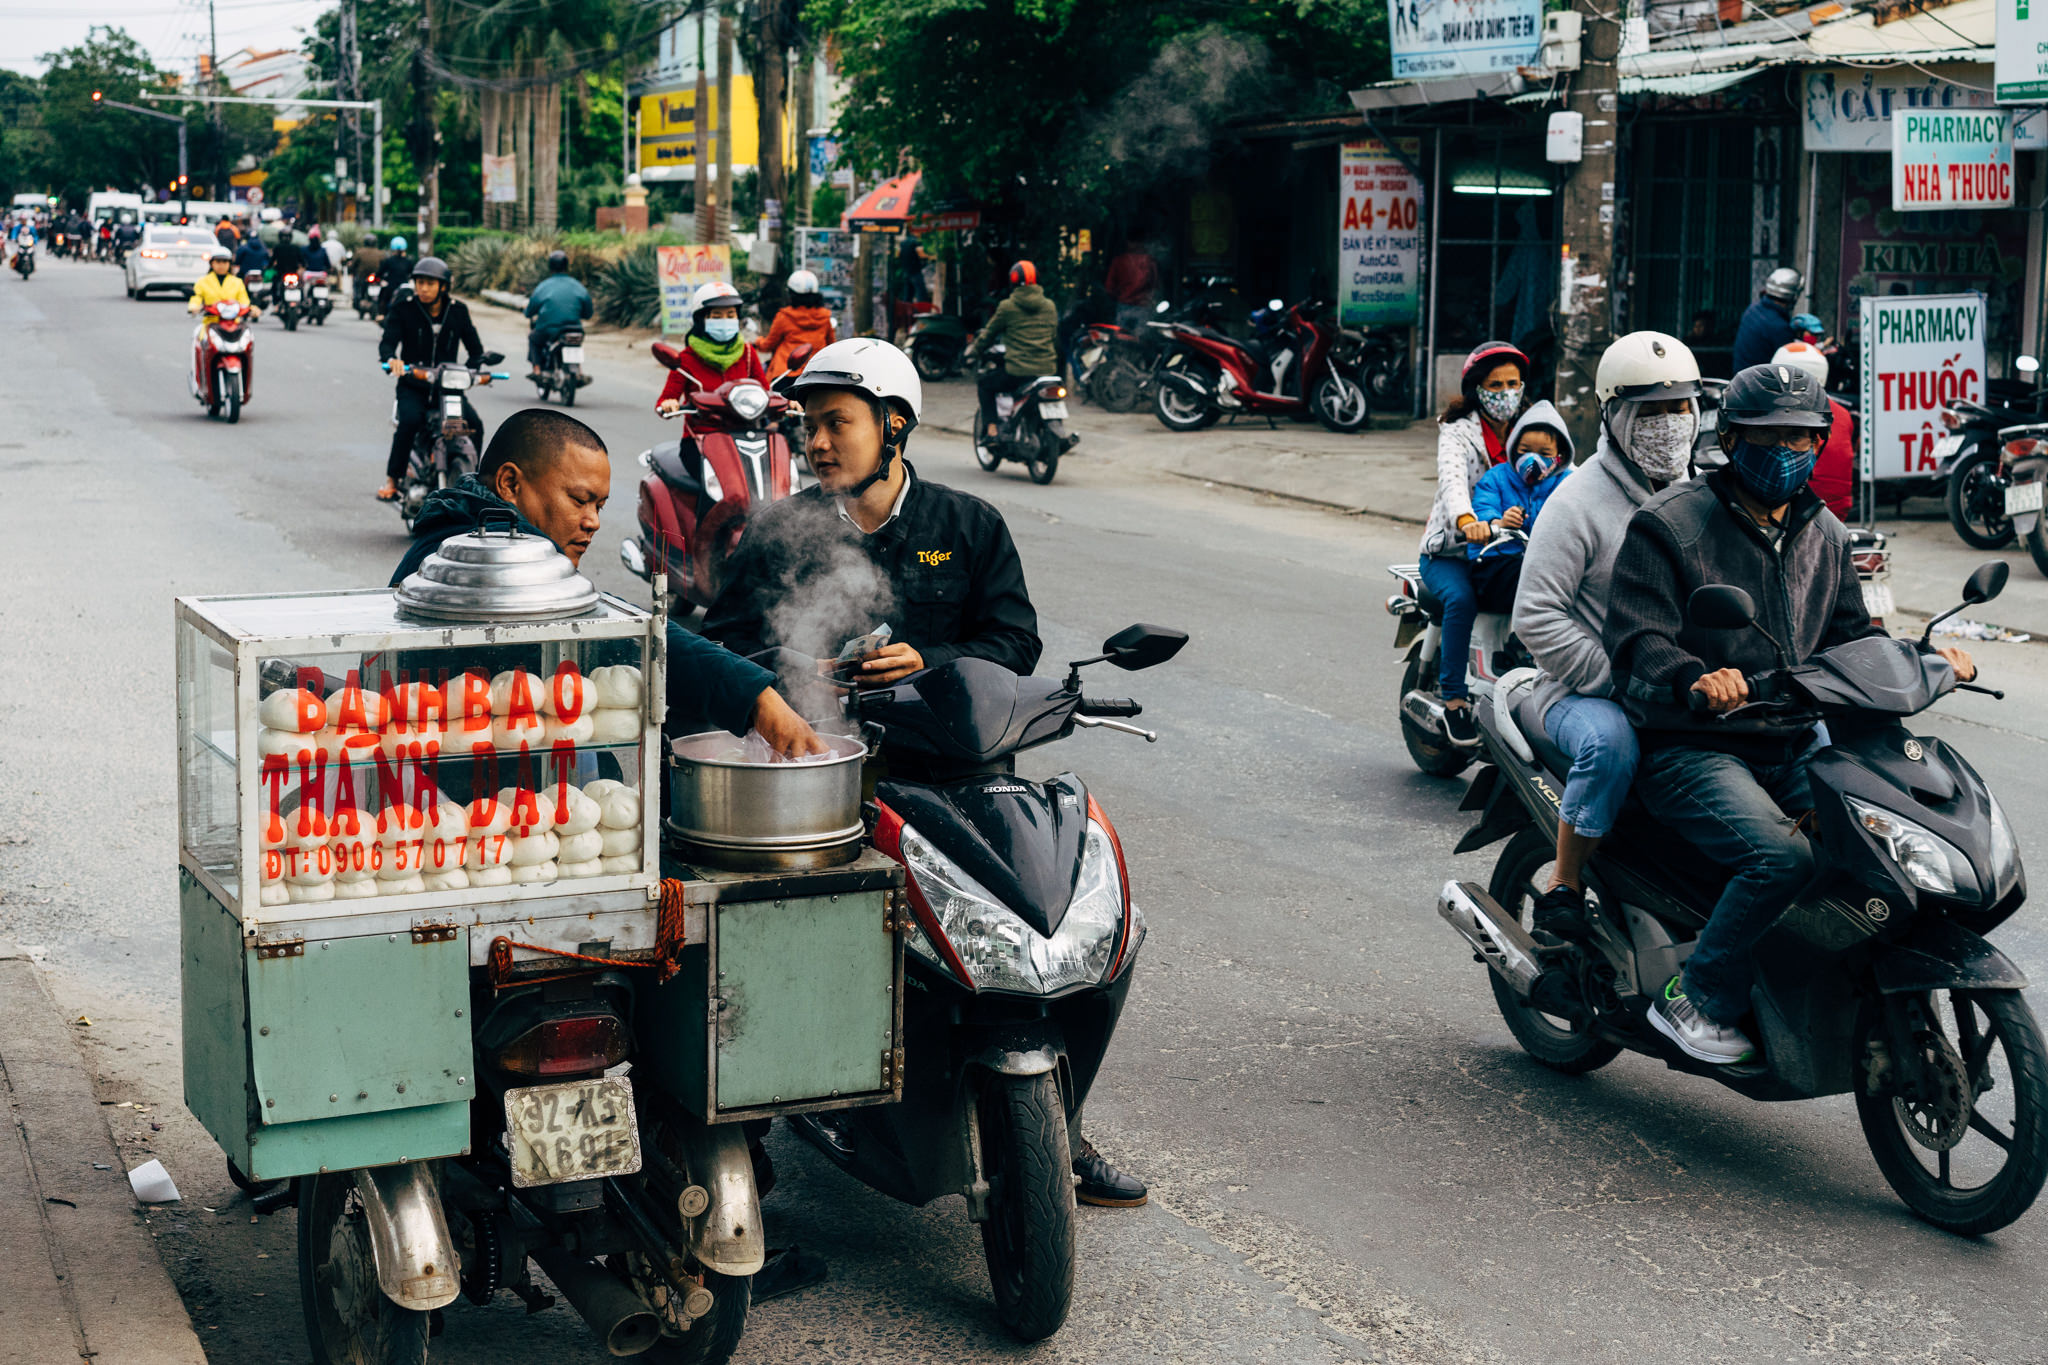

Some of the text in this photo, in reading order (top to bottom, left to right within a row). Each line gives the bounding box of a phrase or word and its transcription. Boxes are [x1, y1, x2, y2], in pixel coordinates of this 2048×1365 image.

[1907, 116, 2007, 143] PHARMACY
[1904, 152, 1942, 201] NHÀ
[1948, 147, 2011, 201] THUỐC
[1860, 239, 1939, 274] KIM
[1879, 306, 1978, 344] PHARMACY
[1878, 353, 1979, 412] THUỐC
[1899, 421, 1946, 472] TÂ
[916, 549, 953, 567] Tiger
[296, 652, 584, 736] BÁNH BAO
[261, 733, 576, 843] THÀNH ĐẠT
[1530, 776, 1562, 809] NO
